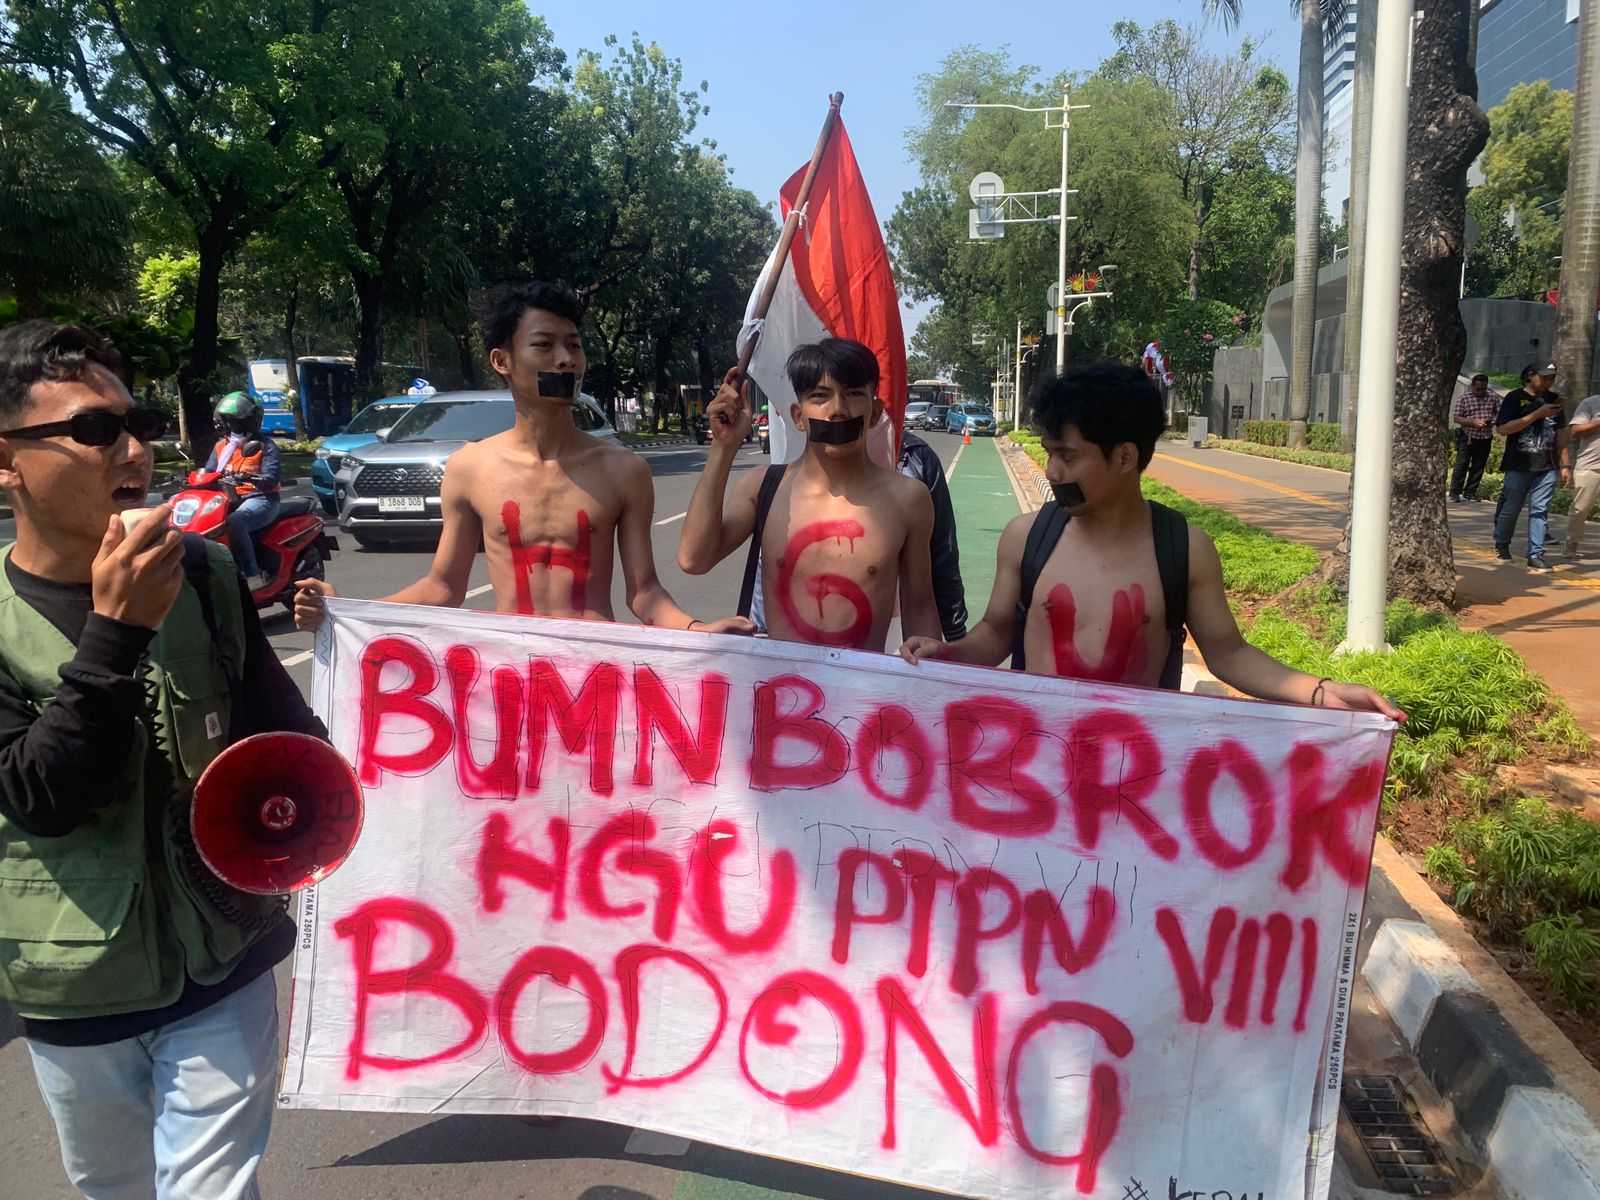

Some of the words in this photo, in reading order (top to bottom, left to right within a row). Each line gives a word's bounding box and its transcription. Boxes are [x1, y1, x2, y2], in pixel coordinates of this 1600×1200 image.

[503, 500, 592, 615] H
[1046, 582, 1147, 683] U
[357, 634, 733, 800] BUMN
[750, 673, 1384, 892] BOBROK
[304, 885, 314, 916] ATAMA
[302, 919, 312, 949] 250PCS
[478, 810, 797, 955] HGU
[832, 848, 1118, 996] PTPN
[1155, 907, 1317, 1031] VIII
[1345, 931, 1355, 943] BU
[1347, 912, 1358, 928] 2X1
[1341, 946, 1352, 975] HIMMA
[1336, 987, 1347, 1009] DIAN
[335, 898, 1134, 1194] BODONG
[1331, 1012, 1344, 1054] PRATAMA
[1328, 1056, 1340, 1090] 250PCS
